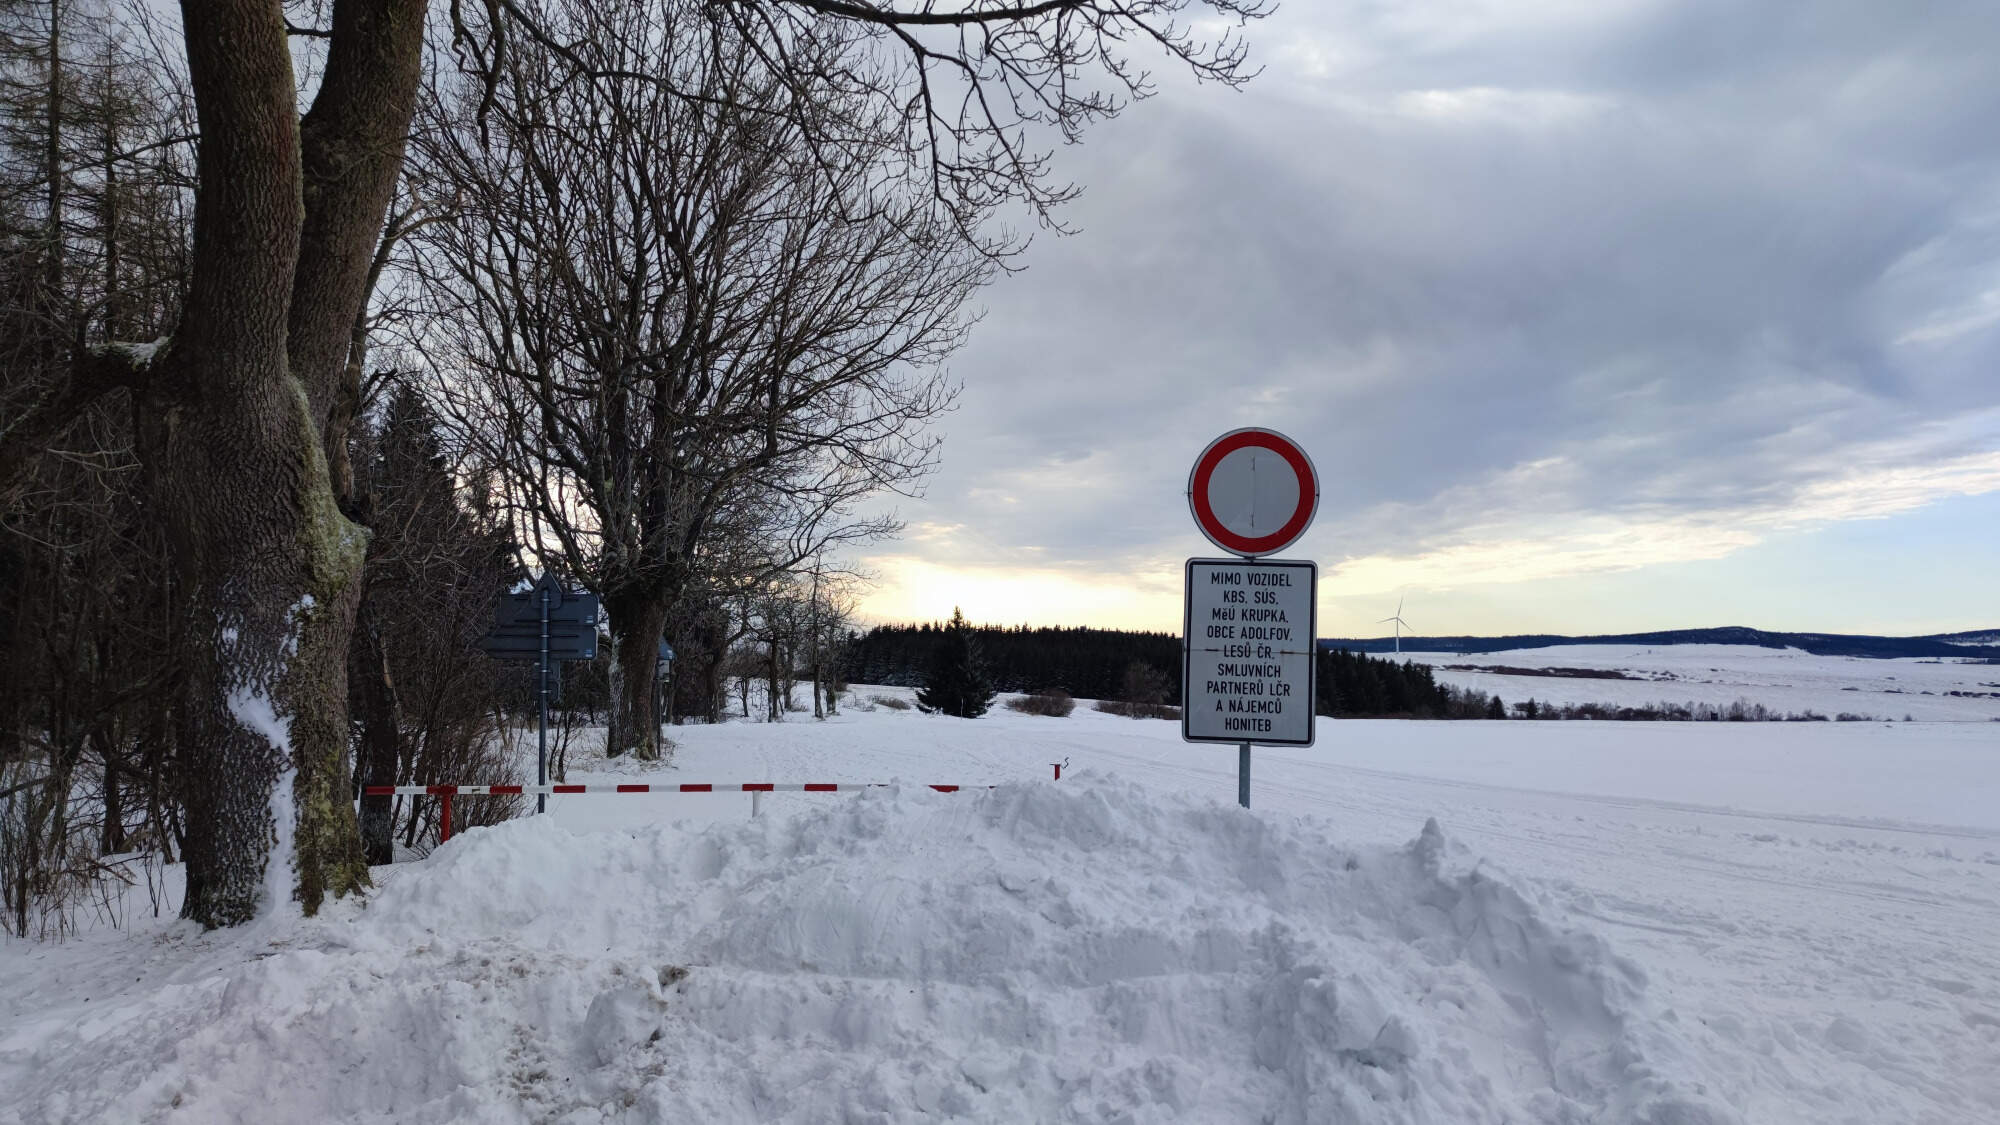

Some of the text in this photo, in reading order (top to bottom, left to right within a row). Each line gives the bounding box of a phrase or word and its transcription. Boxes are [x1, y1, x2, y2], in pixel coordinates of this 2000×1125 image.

[1211, 572, 1292, 586] MIMO VOZIDEL
[1212, 605, 1235, 620] MěÚ
[1207, 626, 1235, 638] OBCE
[1224, 641, 1250, 658] LESŮ
[1218, 662, 1281, 678] SMLUVNÍCH
[1207, 679, 1290, 696] PARTNERŮ LČR
[1216, 696, 1281, 714] A NÁJEMCŮ
[1225, 718, 1271, 732] HONITEB
